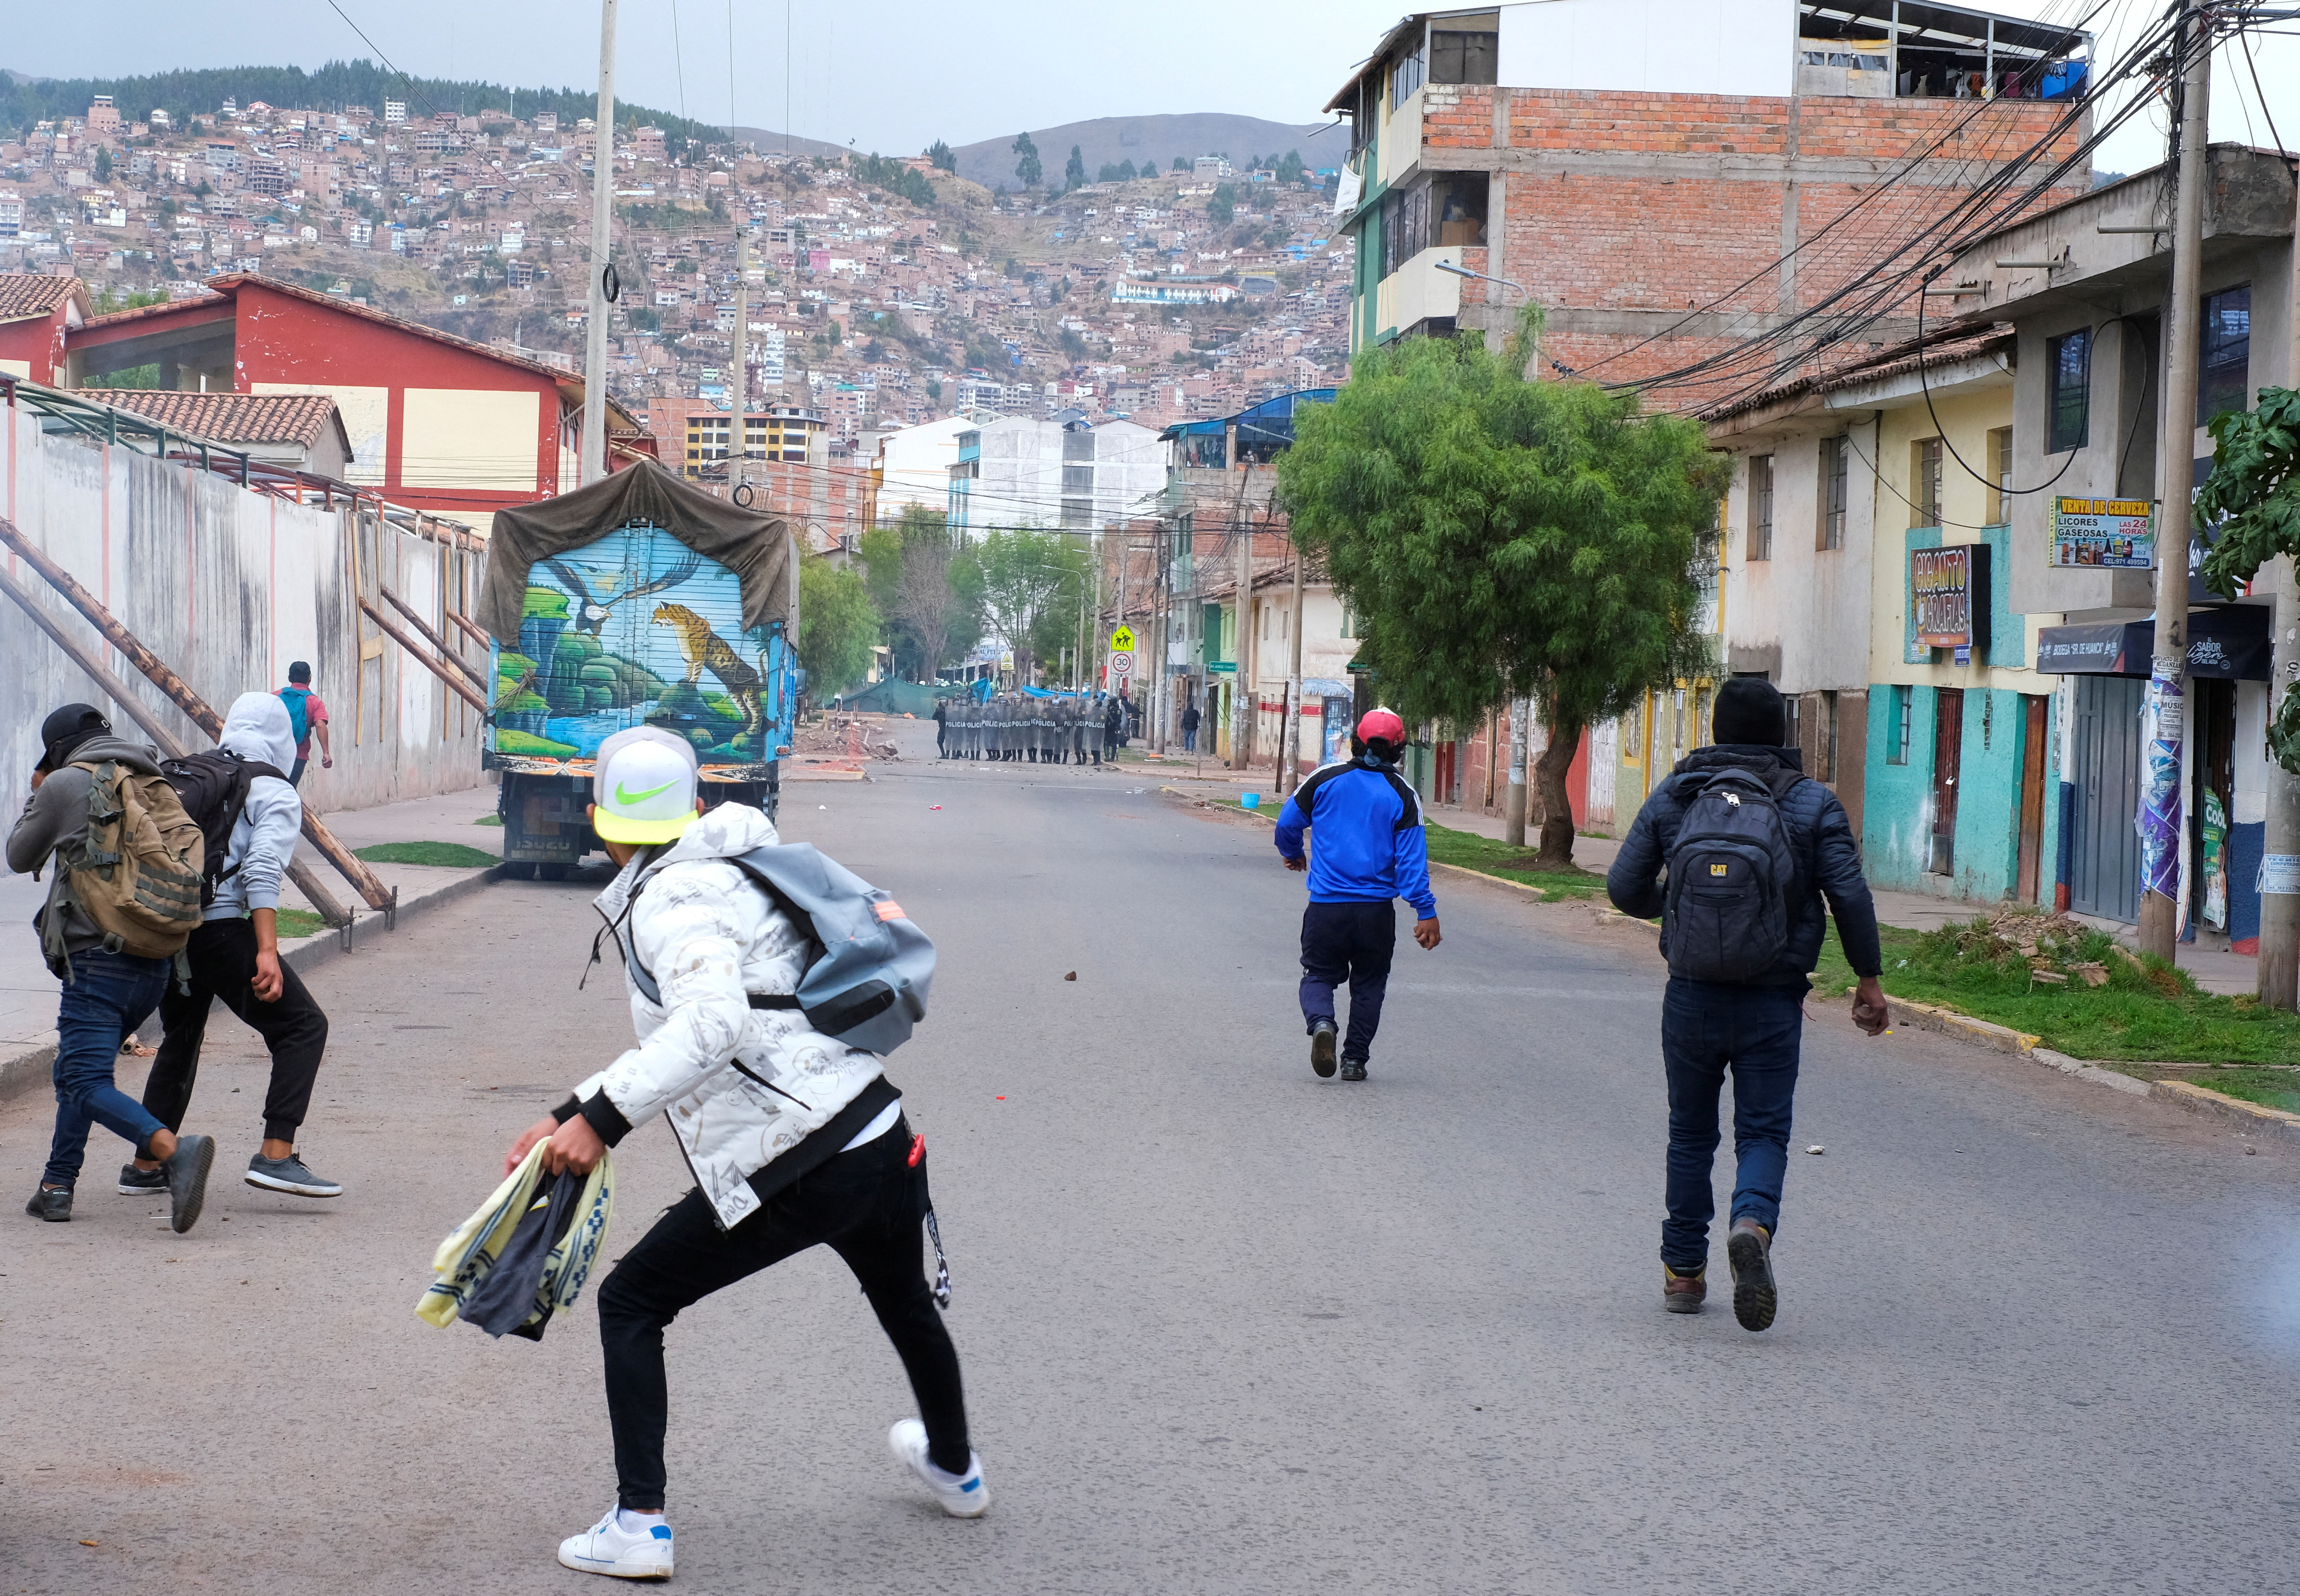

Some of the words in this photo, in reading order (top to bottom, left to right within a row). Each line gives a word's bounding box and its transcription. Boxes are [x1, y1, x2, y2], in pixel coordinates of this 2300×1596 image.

[2061, 499, 2091, 515] VENTA
[2093, 500, 2106, 515] DE
[2108, 501, 2149, 517] CERVEZA
[2058, 528, 2108, 537] GASEOSAS
[1915, 550, 1965, 593] GIGANTO
[1926, 593, 1965, 633] GRAFIAS
[2053, 644, 2070, 656] BODEGA
[2079, 643, 2085, 654] DE
[2197, 642, 2221, 652] SABOR
[2186, 645, 2227, 664] ligero
[517, 840, 570, 850] ISUZU
[1710, 864, 1727, 876] CAT
